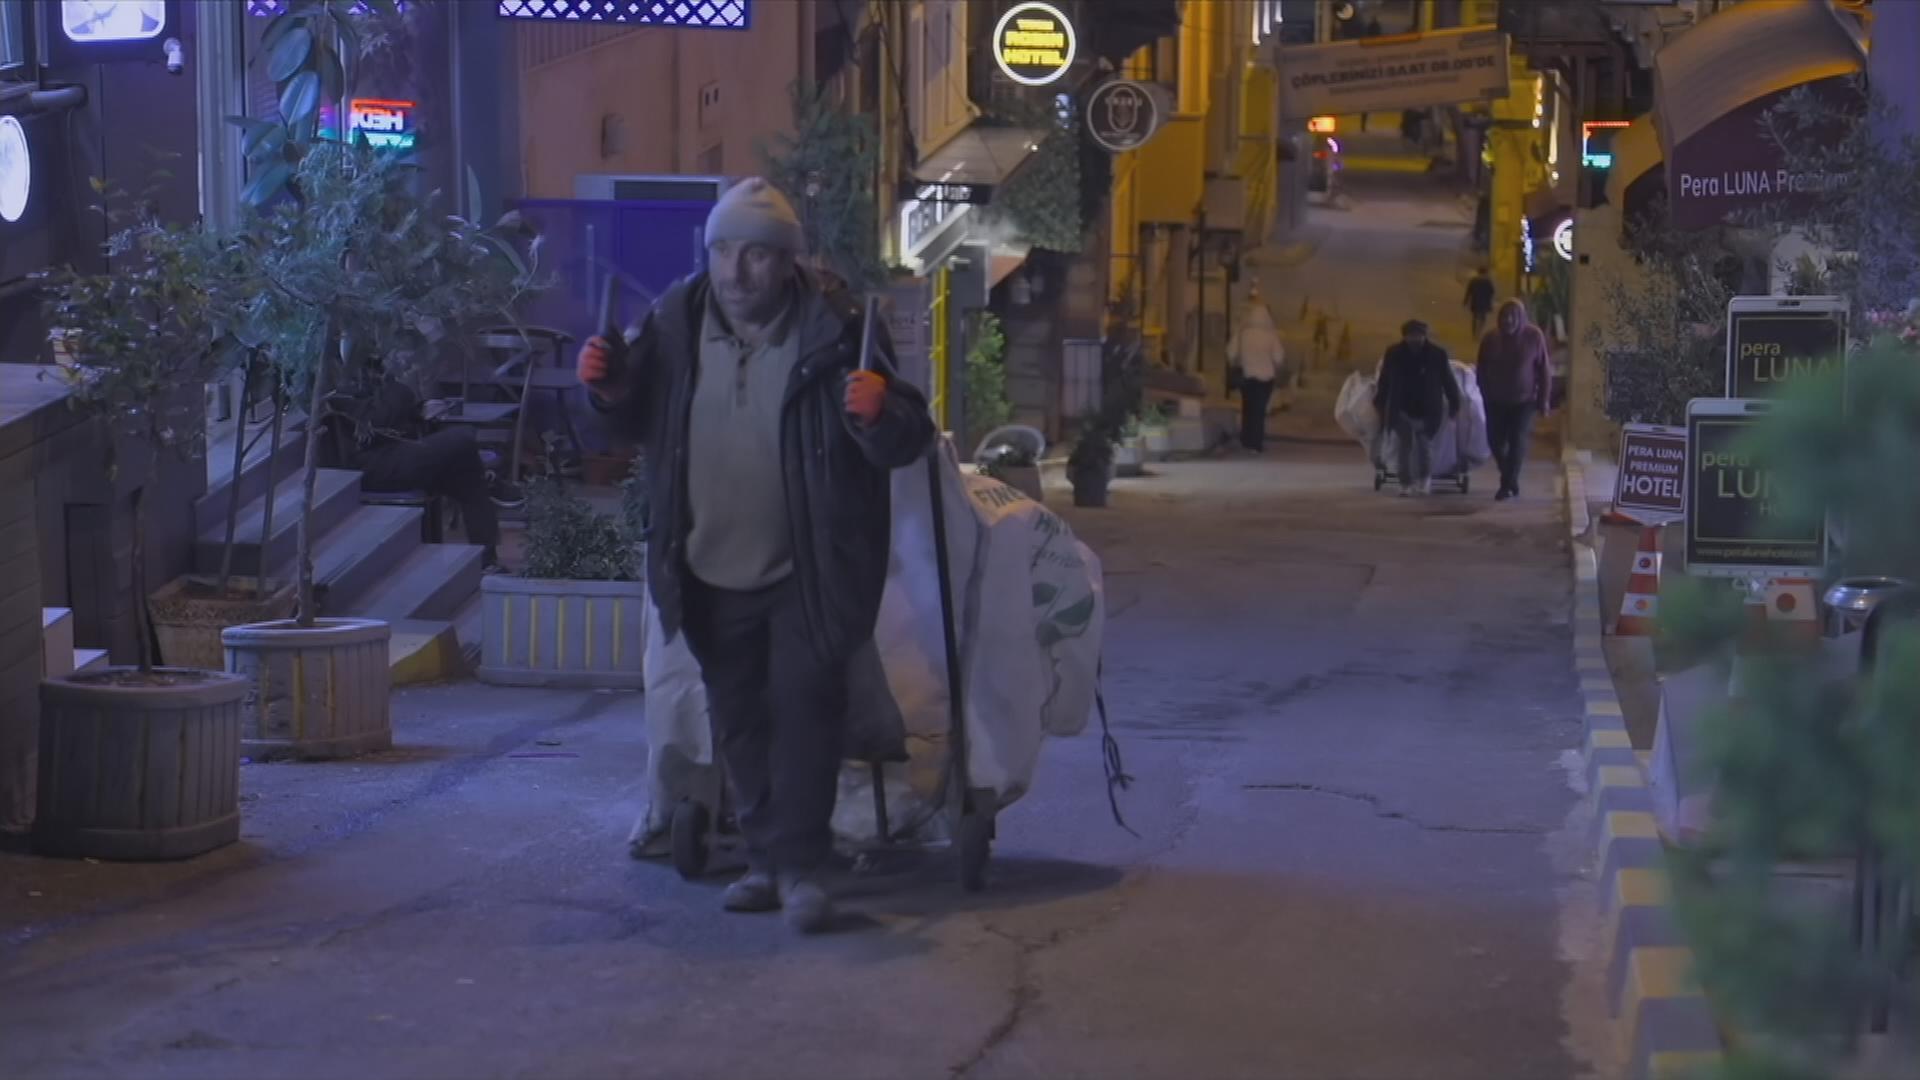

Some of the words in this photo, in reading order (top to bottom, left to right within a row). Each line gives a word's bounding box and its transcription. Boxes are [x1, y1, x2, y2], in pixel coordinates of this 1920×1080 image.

[1388, 62, 1427, 78] SAAT
[1680, 173, 1719, 197] Pera
[1724, 170, 1770, 195] LUNA
[1740, 342, 1781, 360] pera
[1628, 445, 1653, 458] PERA
[1656, 447, 1683, 461] LUNA
[1701, 451, 1749, 471] pera
[1629, 460, 1678, 474] PREMIUM
[1623, 475, 1681, 499] HOTEL
